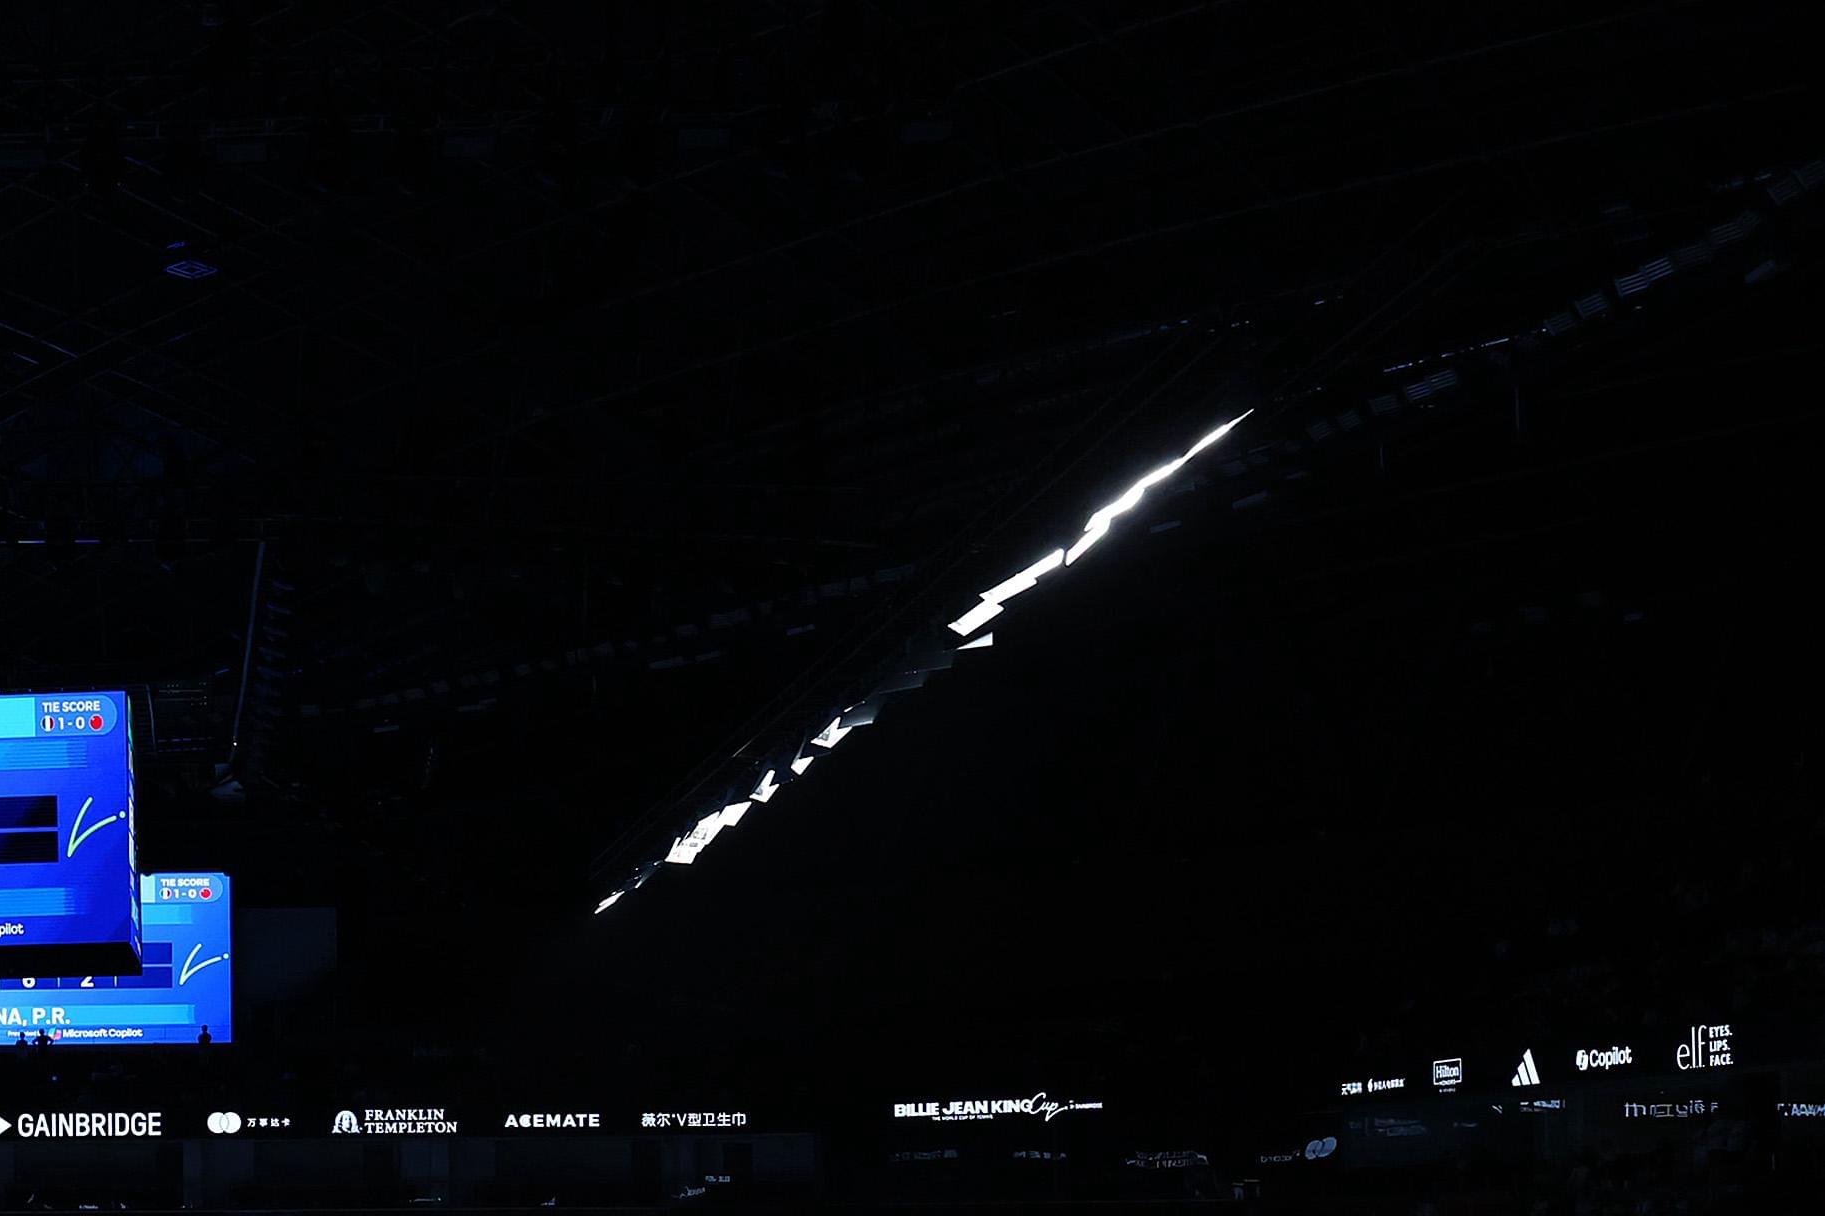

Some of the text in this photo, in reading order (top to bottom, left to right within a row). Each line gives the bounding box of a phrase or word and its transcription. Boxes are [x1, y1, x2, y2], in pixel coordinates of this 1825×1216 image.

[42, 700, 101, 712] TIE SCORE
[160, 878, 210, 886] TIE SCORE
[32, 1008, 70, 1024] P.R.
[63, 1028, 142, 1039] Microsoft Copilot
[1709, 1025, 1733, 1038] EYES.
[1709, 1039, 1730, 1052] LIPS.
[1589, 1046, 1632, 1070] Copilot
[1710, 1053, 1733, 1066] FACE.
[894, 1102, 940, 1117] BILLIE
[942, 1101, 989, 1115] JEAN
[991, 1099, 1032, 1114] KING
[365, 1109, 444, 1121] FRANKLIN
[504, 1113, 601, 1128] ACEMATE
[17, 1112, 162, 1137] GAINBRIDGE
[364, 1122, 458, 1134] TEMPLETON
